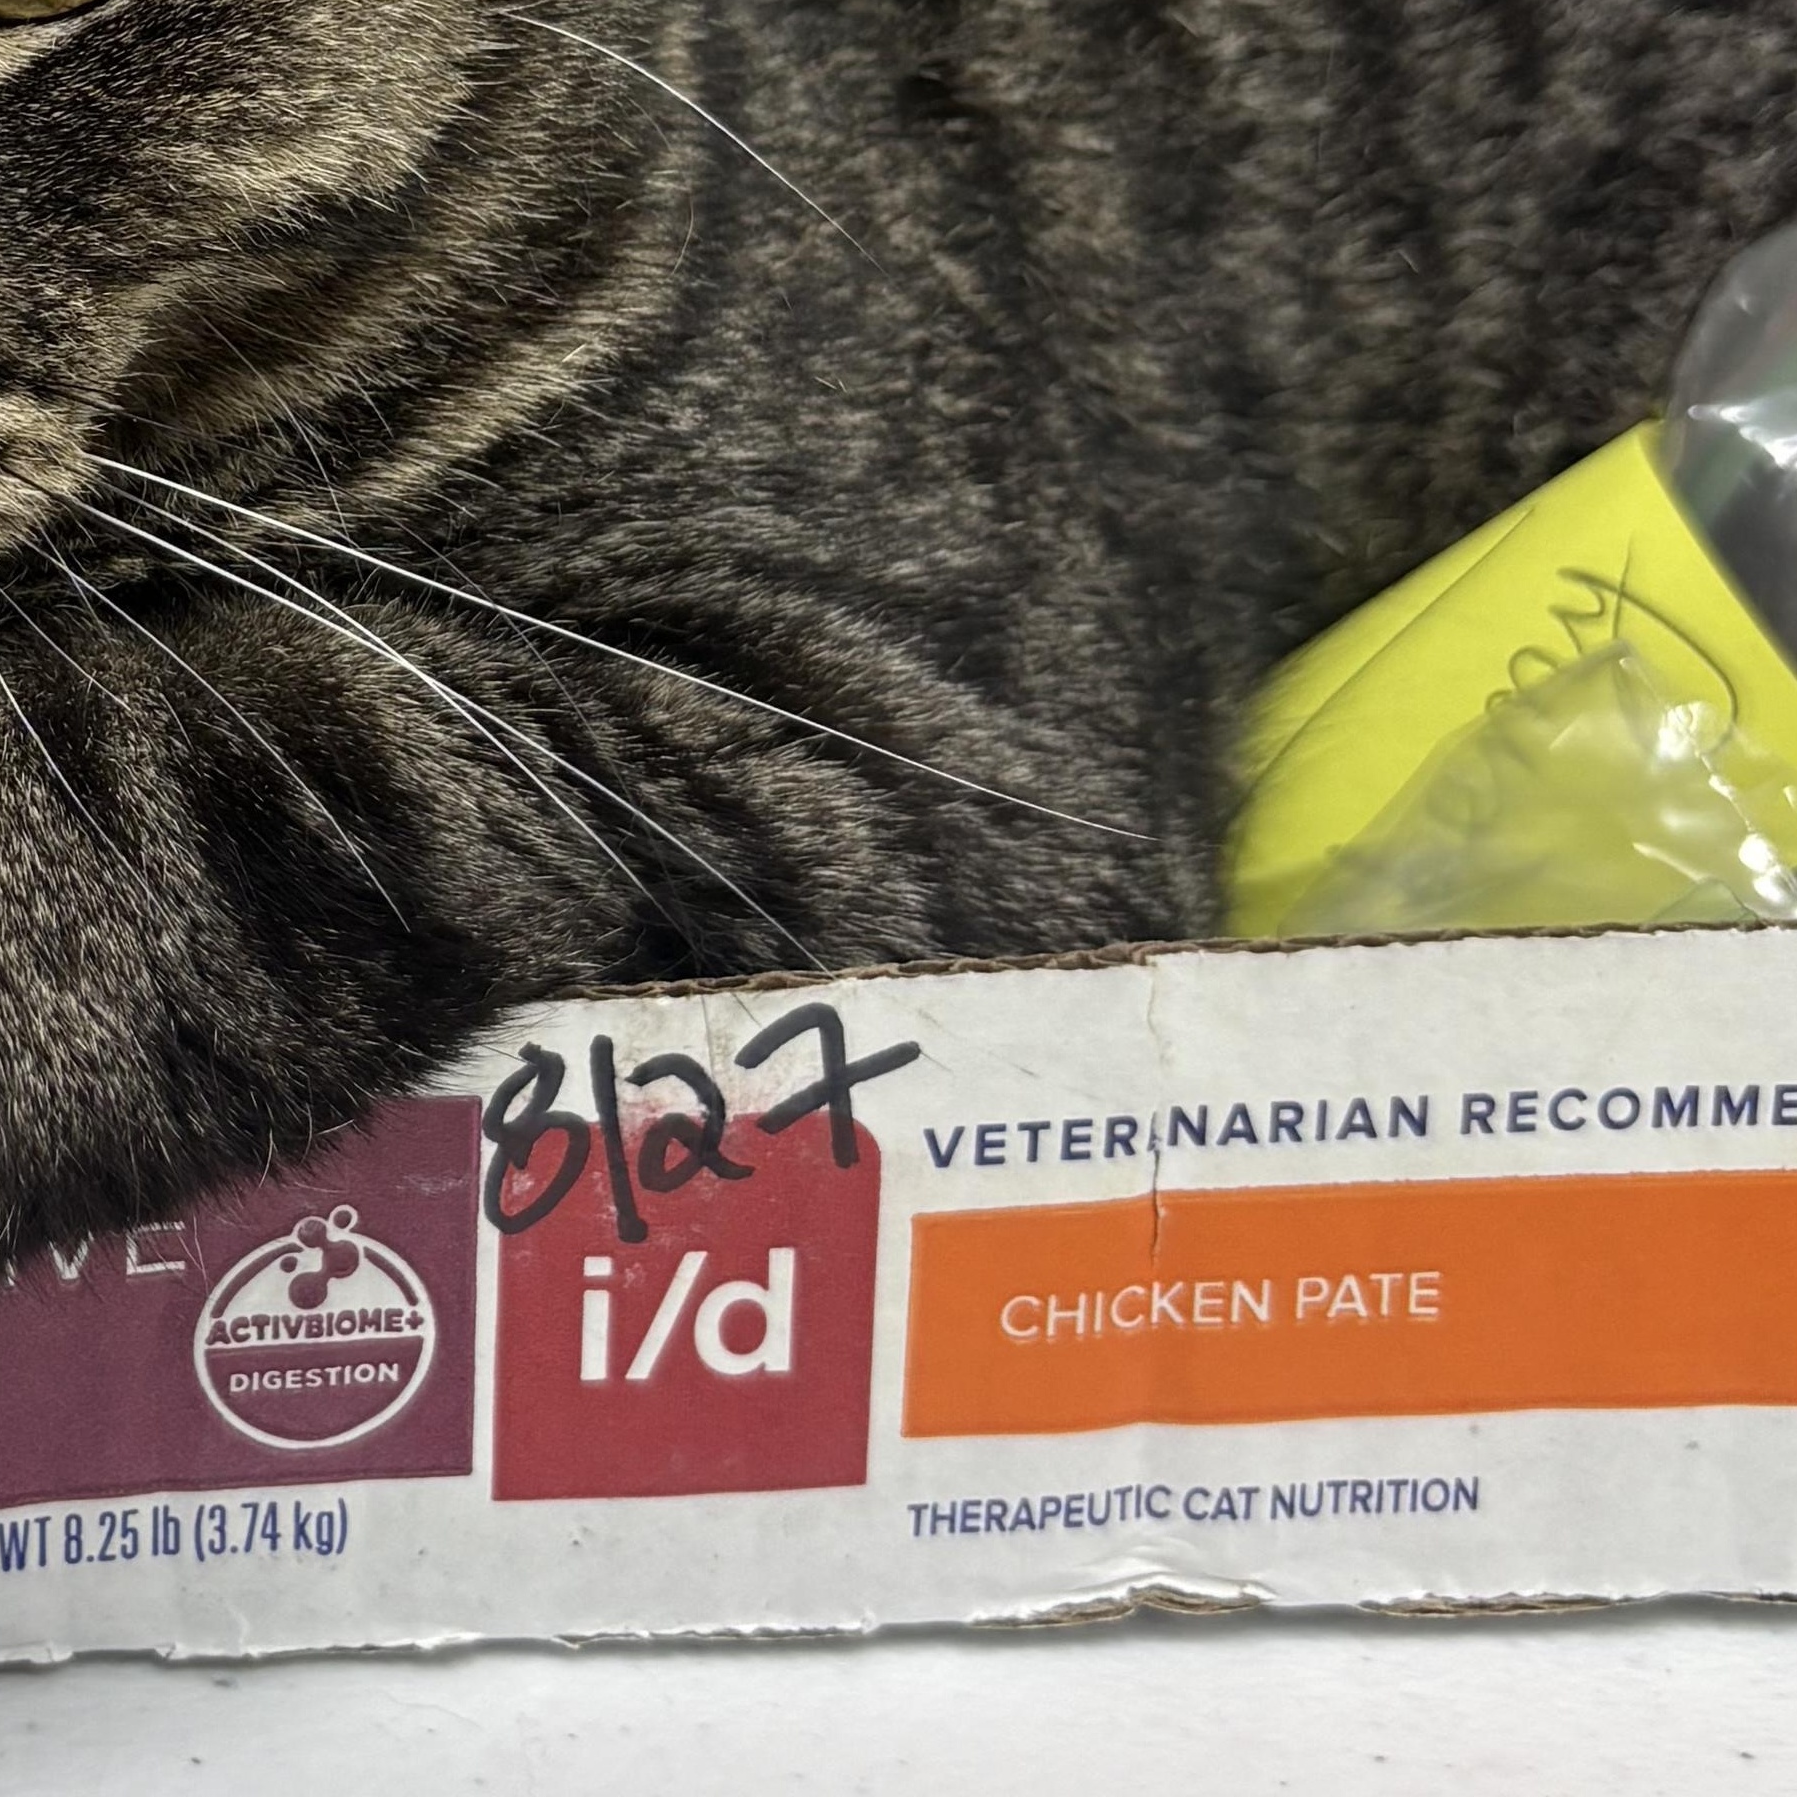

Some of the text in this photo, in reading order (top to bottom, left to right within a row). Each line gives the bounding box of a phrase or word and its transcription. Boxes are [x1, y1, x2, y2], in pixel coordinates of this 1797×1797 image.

[924, 1084, 1797, 1170] VETERINARIAN RECOMME
[580, 1246, 796, 1382] i/d
[1000, 1270, 1442, 1340] CHICKEN PATE
[229, 1361, 400, 1394] DIGESTION
[63, 1508, 140, 1565] 8.25
[151, 1504, 182, 1557] lb
[193, 1500, 282, 1562] (3.74
[293, 1497, 349, 1557] kg)
[907, 1475, 1481, 1537] THERAPEUTIC CAT NUTRITION
